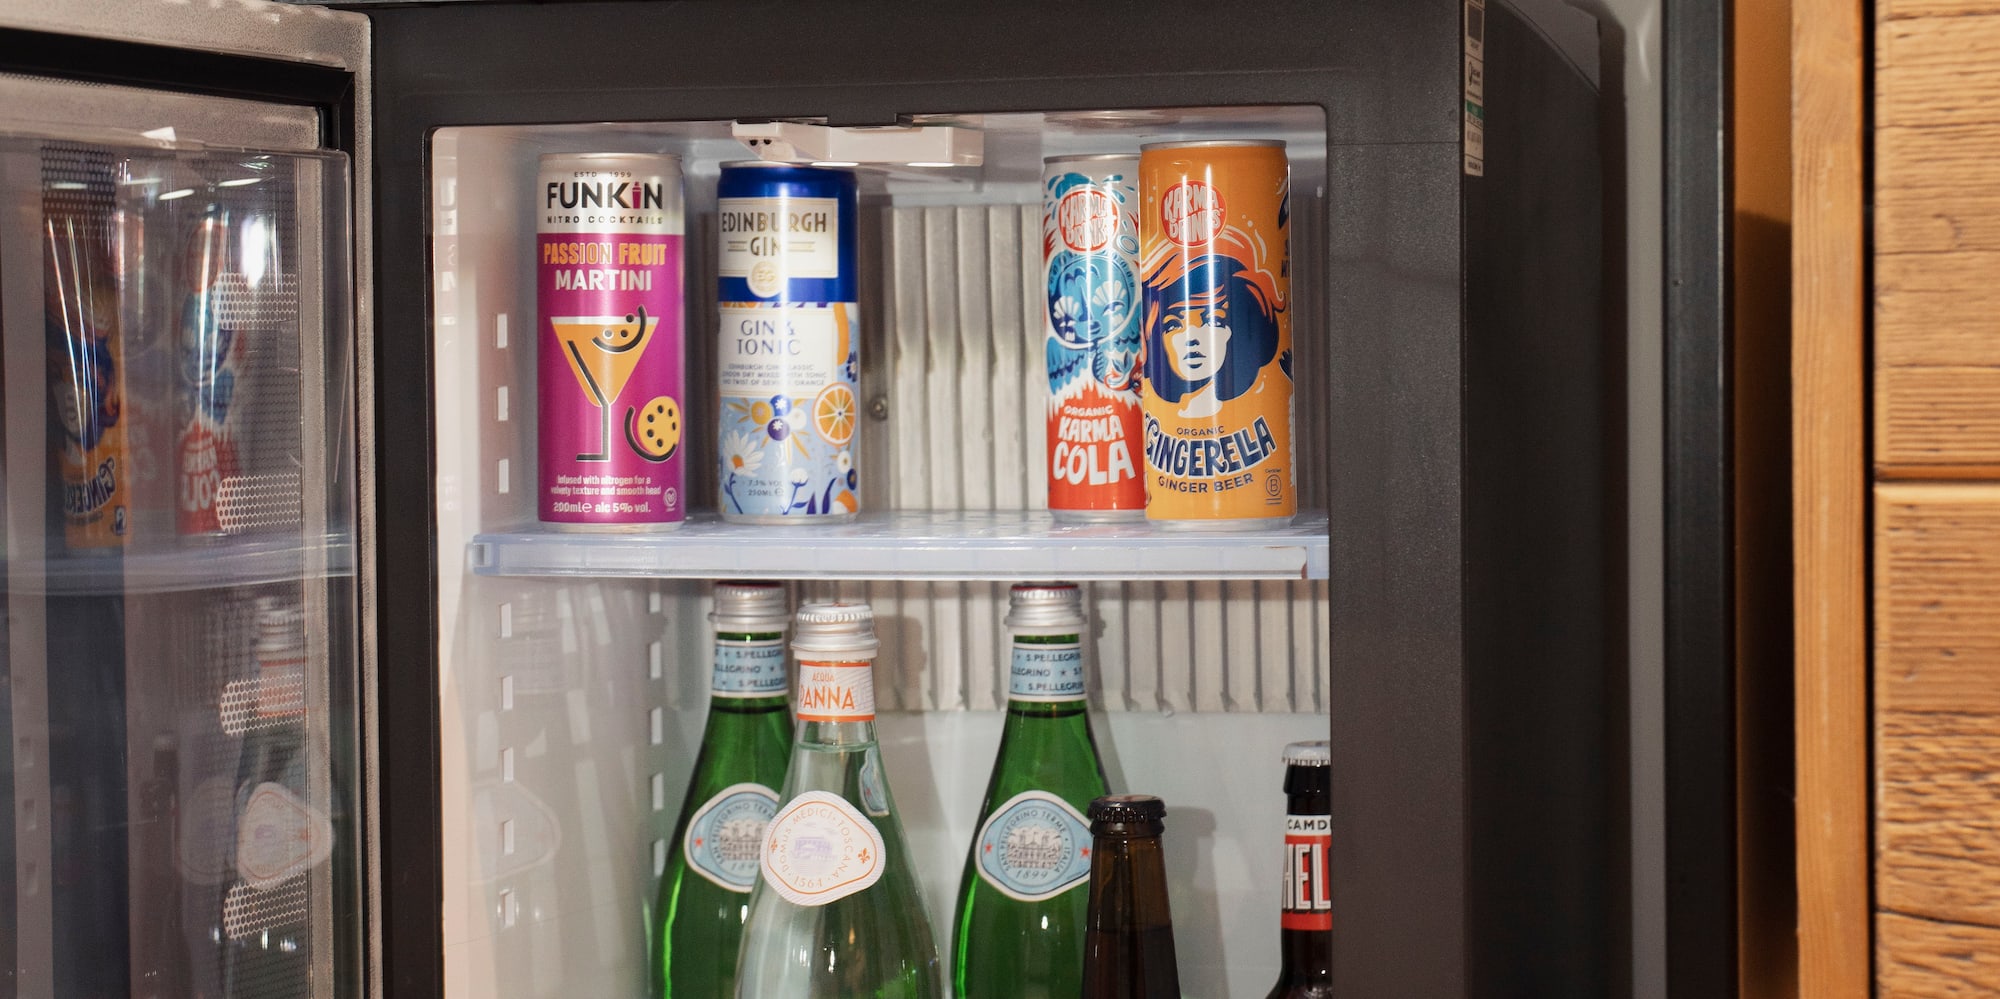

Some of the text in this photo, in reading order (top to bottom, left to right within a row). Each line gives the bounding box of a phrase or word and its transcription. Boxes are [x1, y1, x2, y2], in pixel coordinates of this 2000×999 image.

[1164, 186, 1219, 222] KARMA
[547, 215, 664, 224] NITRO COCKTAILS
[722, 212, 827, 233] EDINBURGH
[543, 242, 667, 266] PASSION FRUIT
[555, 269, 652, 291] MARTINI
[740, 319, 775, 336] GIN
[736, 338, 801, 355] TONIC
[1063, 405, 1114, 418] ORGANIC
[1058, 415, 1124, 443] KARMA
[1176, 426, 1225, 436] ORGANIC
[1145, 411, 1277, 478] GINGERELLA
[1053, 440, 1137, 486] COLA
[557, 475, 582, 484] Infused
[583, 475, 600, 484] with
[600, 475, 633, 485] nitrogen
[634, 475, 645, 484] for
[1158, 473, 1254, 493] GINGER BEER
[572, 486, 600, 495] texture
[600, 486, 616, 495] and
[617, 486, 644, 495] smooth
[645, 486, 661, 495] head
[595, 502, 610, 513] alc
[612, 502, 632, 513] 5%
[634, 502, 652, 513] vol.
[812, 671, 835, 682] ACQUA
[1287, 819, 1331, 831] CAMD
[779, 828, 792, 874] DOMUS
[793, 808, 830, 825] MEDICI
[833, 820, 854, 879] TOSCANA
[1000, 809, 1071, 873] SAN PELLEGRINO TERME ITALIA
[1015, 870, 1049, 879] 1899
[1282, 843, 1332, 910] HEL
